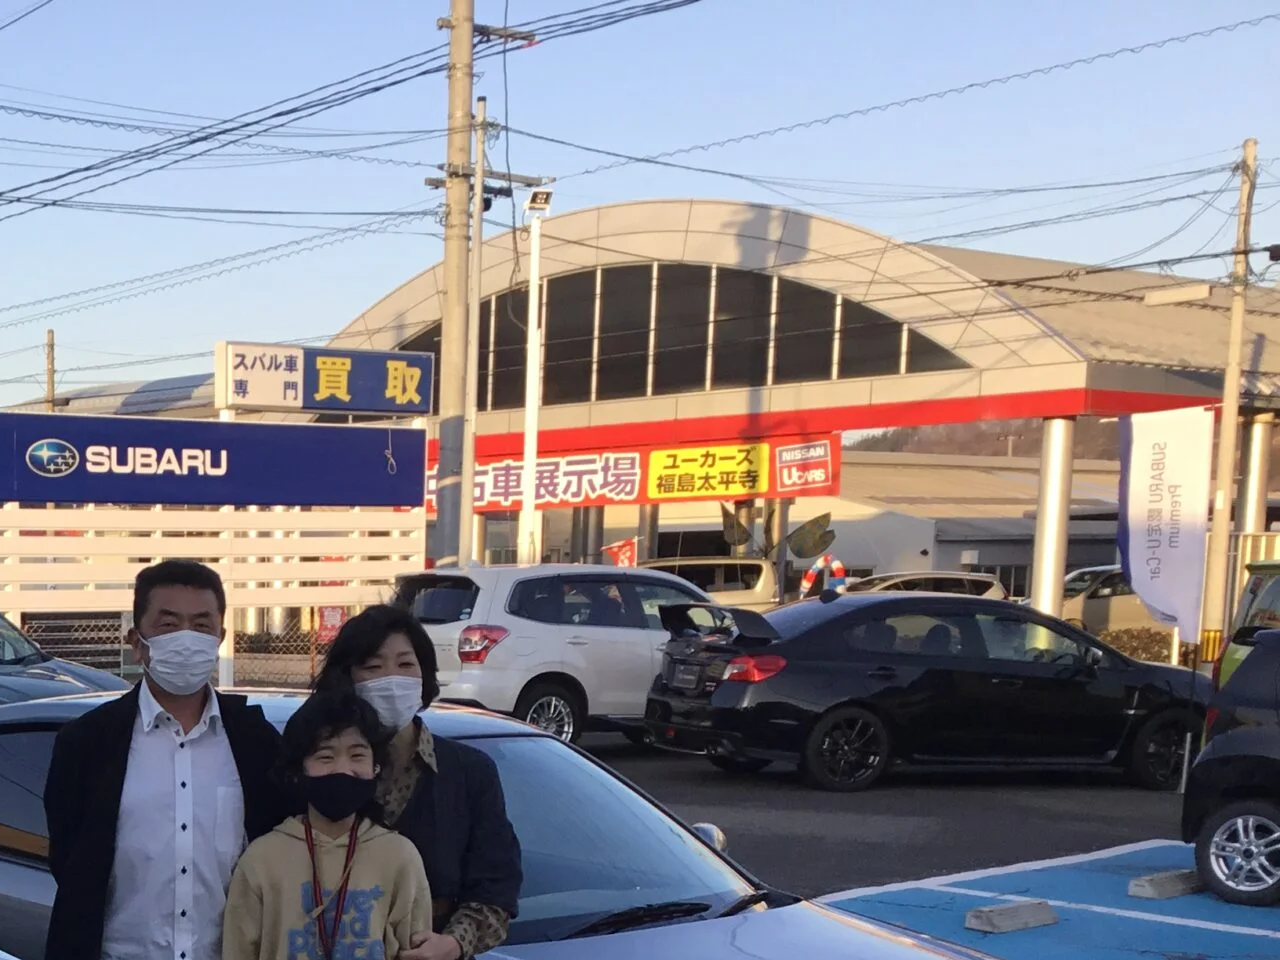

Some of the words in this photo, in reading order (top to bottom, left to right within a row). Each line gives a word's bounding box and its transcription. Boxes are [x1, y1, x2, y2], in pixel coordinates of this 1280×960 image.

[233, 353, 298, 374] スバル車
[233, 379, 298, 401] 専門
[313, 355, 422, 405] 買取
[85, 445, 228, 477] SUBARU
[663, 446, 757, 470] ユーカーズ
[782, 446, 825, 462] NISSAN
[656, 470, 759, 494] 福島太平寺
